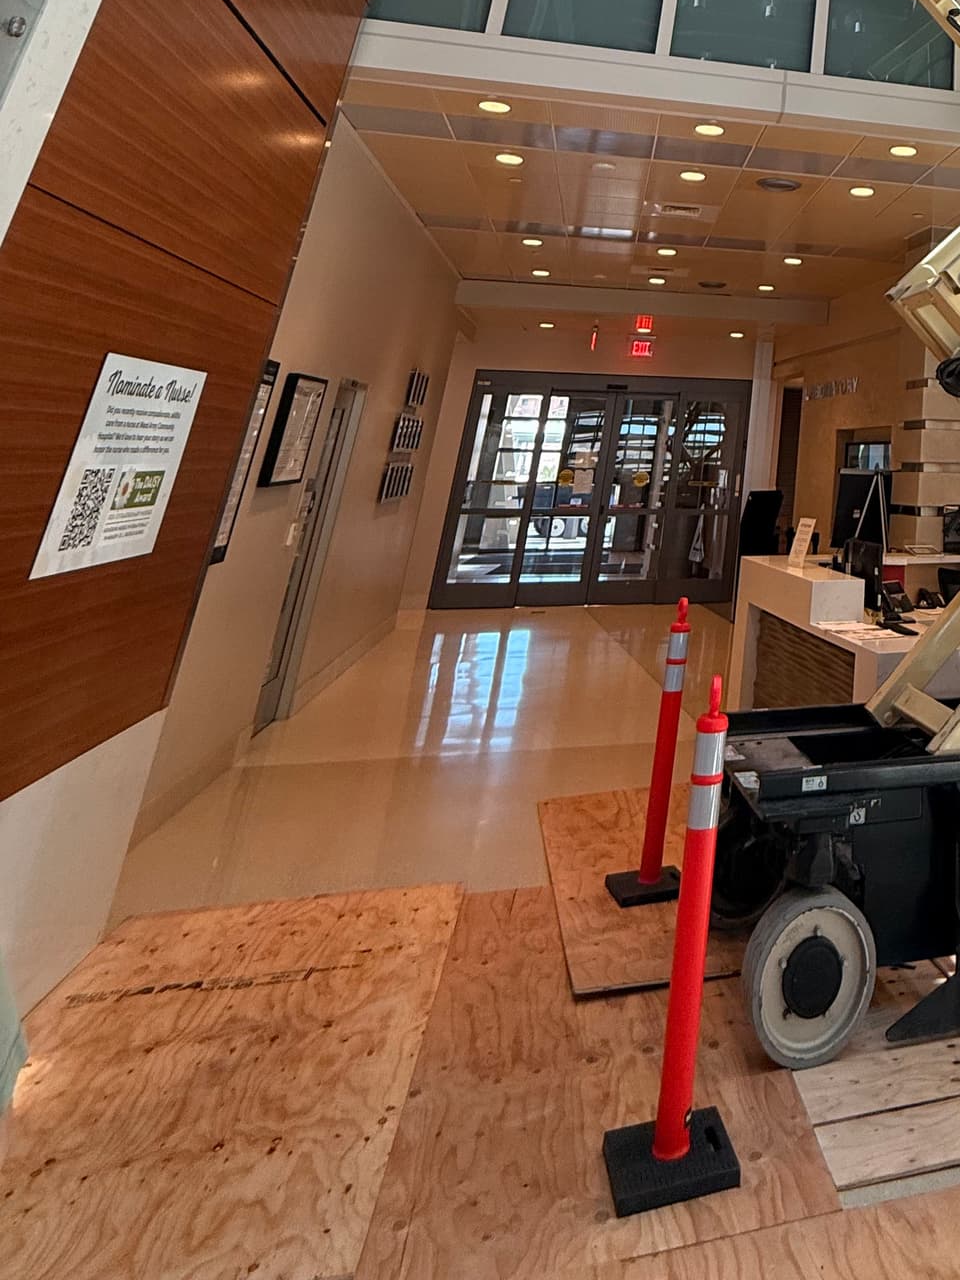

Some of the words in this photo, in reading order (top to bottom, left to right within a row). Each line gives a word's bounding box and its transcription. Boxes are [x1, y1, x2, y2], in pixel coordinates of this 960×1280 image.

[632, 340, 651, 356] EXIT
[106, 369, 156, 399] Nominate
[154, 385, 163, 400] a
[164, 379, 198, 403] Nurse!
